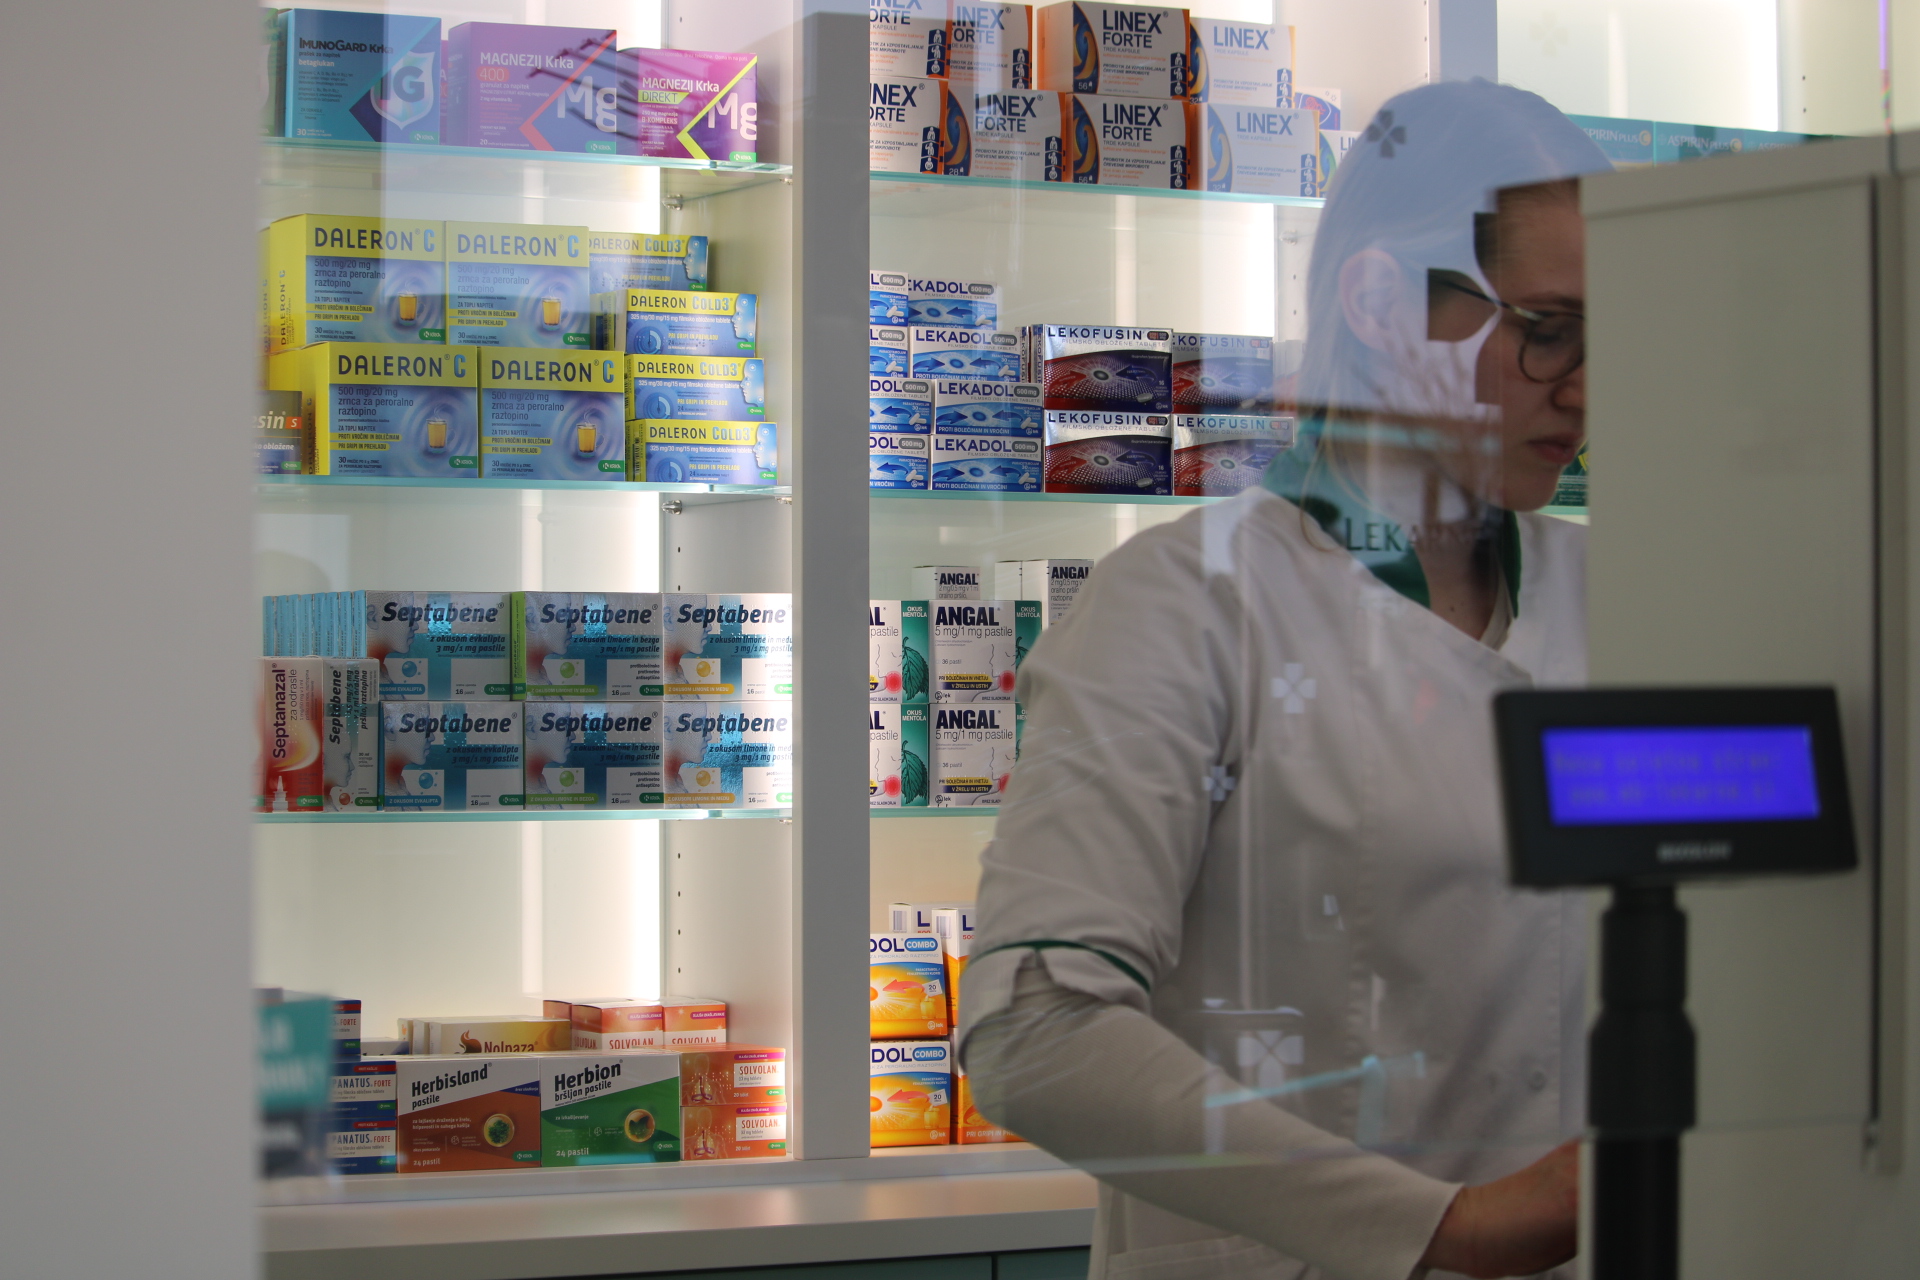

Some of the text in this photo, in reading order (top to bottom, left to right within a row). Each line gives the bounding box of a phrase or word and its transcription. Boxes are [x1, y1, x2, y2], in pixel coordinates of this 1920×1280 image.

[952, 6, 1005, 30] INEX
[1102, 9, 1162, 34] LINEX
[951, 28, 995, 44] ORTE
[1102, 31, 1153, 48] FORTE
[1213, 26, 1270, 50] LINEX
[369, 43, 394, 54] Krka
[298, 59, 335, 67] betaglukan
[480, 52, 574, 69] MAGNEZIJ Krka
[479, 68, 505, 82] 400
[642, 78, 720, 92] MAGNEZIJ Krka
[557, 75, 617, 133] Mg
[642, 90, 678, 103] DIREKT
[975, 93, 1037, 118] LINEX
[707, 92, 758, 141] Mg
[870, 106, 906, 122] RTE
[1102, 102, 1162, 128] LINEX
[975, 116, 1027, 132] FORTE
[1236, 112, 1293, 136] LINEX
[296, 128, 307, 136] 30
[1102, 125, 1153, 142] FORTE
[1618, 132, 1638, 144] PLUS
[1668, 135, 1710, 149] ASPIRIN
[1709, 139, 1730, 151] PLUS
[314, 227, 436, 252] DALERON C
[457, 233, 579, 258] DALERON C
[631, 296, 687, 308] DALERON
[915, 329, 992, 346] LEKADOL
[1048, 327, 1142, 340] LEKOFUSIN
[1172, 335, 1245, 348] KOFUSIN
[338, 354, 467, 378] DALERON C
[491, 359, 614, 384] DALERON C
[638, 362, 694, 375] DALERON
[338, 386, 398, 398] 500 mg/20 mg
[870, 380, 903, 393] DOL
[938, 382, 1014, 397] LEKADOL
[338, 398, 414, 408] zrnca za peroralno
[491, 391, 550, 402] 500 mg/20 mg
[338, 407, 377, 418] raztopino
[491, 402, 514, 410] zrnca
[527, 402, 565, 412] peroralno
[491, 411, 529, 422] raztopino
[1048, 412, 1142, 425] LEKOFUSIN
[1177, 417, 1265, 430] LEKOFUSIN
[650, 426, 707, 440] DALERON
[953, 426, 983, 434] BOLEČINAM
[935, 438, 1012, 453] LEKADOL
[939, 573, 979, 586] ANGAL
[381, 601, 499, 628] Septabene
[540, 603, 652, 628] Septabene
[676, 603, 786, 628] Septabene
[935, 606, 1000, 626] ANGAL
[436, 635, 468, 643] okusom
[469, 635, 506, 644] evkalipta
[870, 626, 899, 638] pastile
[934, 626, 1013, 639] 5 mg/1 mg pastile
[606, 646, 624, 654] mg/1
[624, 646, 636, 654] mg
[636, 646, 660, 654] pastile
[289, 668, 298, 721] za odrasle
[360, 670, 368, 730] pršilo, raztopina
[272, 668, 290, 759] Septanazal
[329, 669, 344, 745] Septabene
[399, 712, 512, 738] Septabene
[540, 712, 652, 738] Septabene
[676, 712, 788, 738] Septabene
[936, 710, 1000, 730] ANGAL
[870, 730, 899, 742] pastile
[936, 730, 1013, 742] 5 mg/1 mg pastile
[906, 941, 936, 949] COMBO
[340, 1018, 356, 1026] FORTE
[484, 1041, 535, 1053] Nolpaza
[609, 1038, 654, 1050] SOLVOLAN
[872, 1048, 945, 1063] DOL COMBO
[554, 1062, 622, 1092] Herbion
[739, 1064, 777, 1076] SOLVOLAN
[411, 1063, 488, 1098] Herbisland
[554, 1080, 612, 1102] bršljan pastile
[412, 1094, 440, 1111] pastile
[741, 1118, 778, 1129] SOLVOLAN
[567, 1147, 589, 1157] pastil
[422, 1158, 441, 1166] pastil
